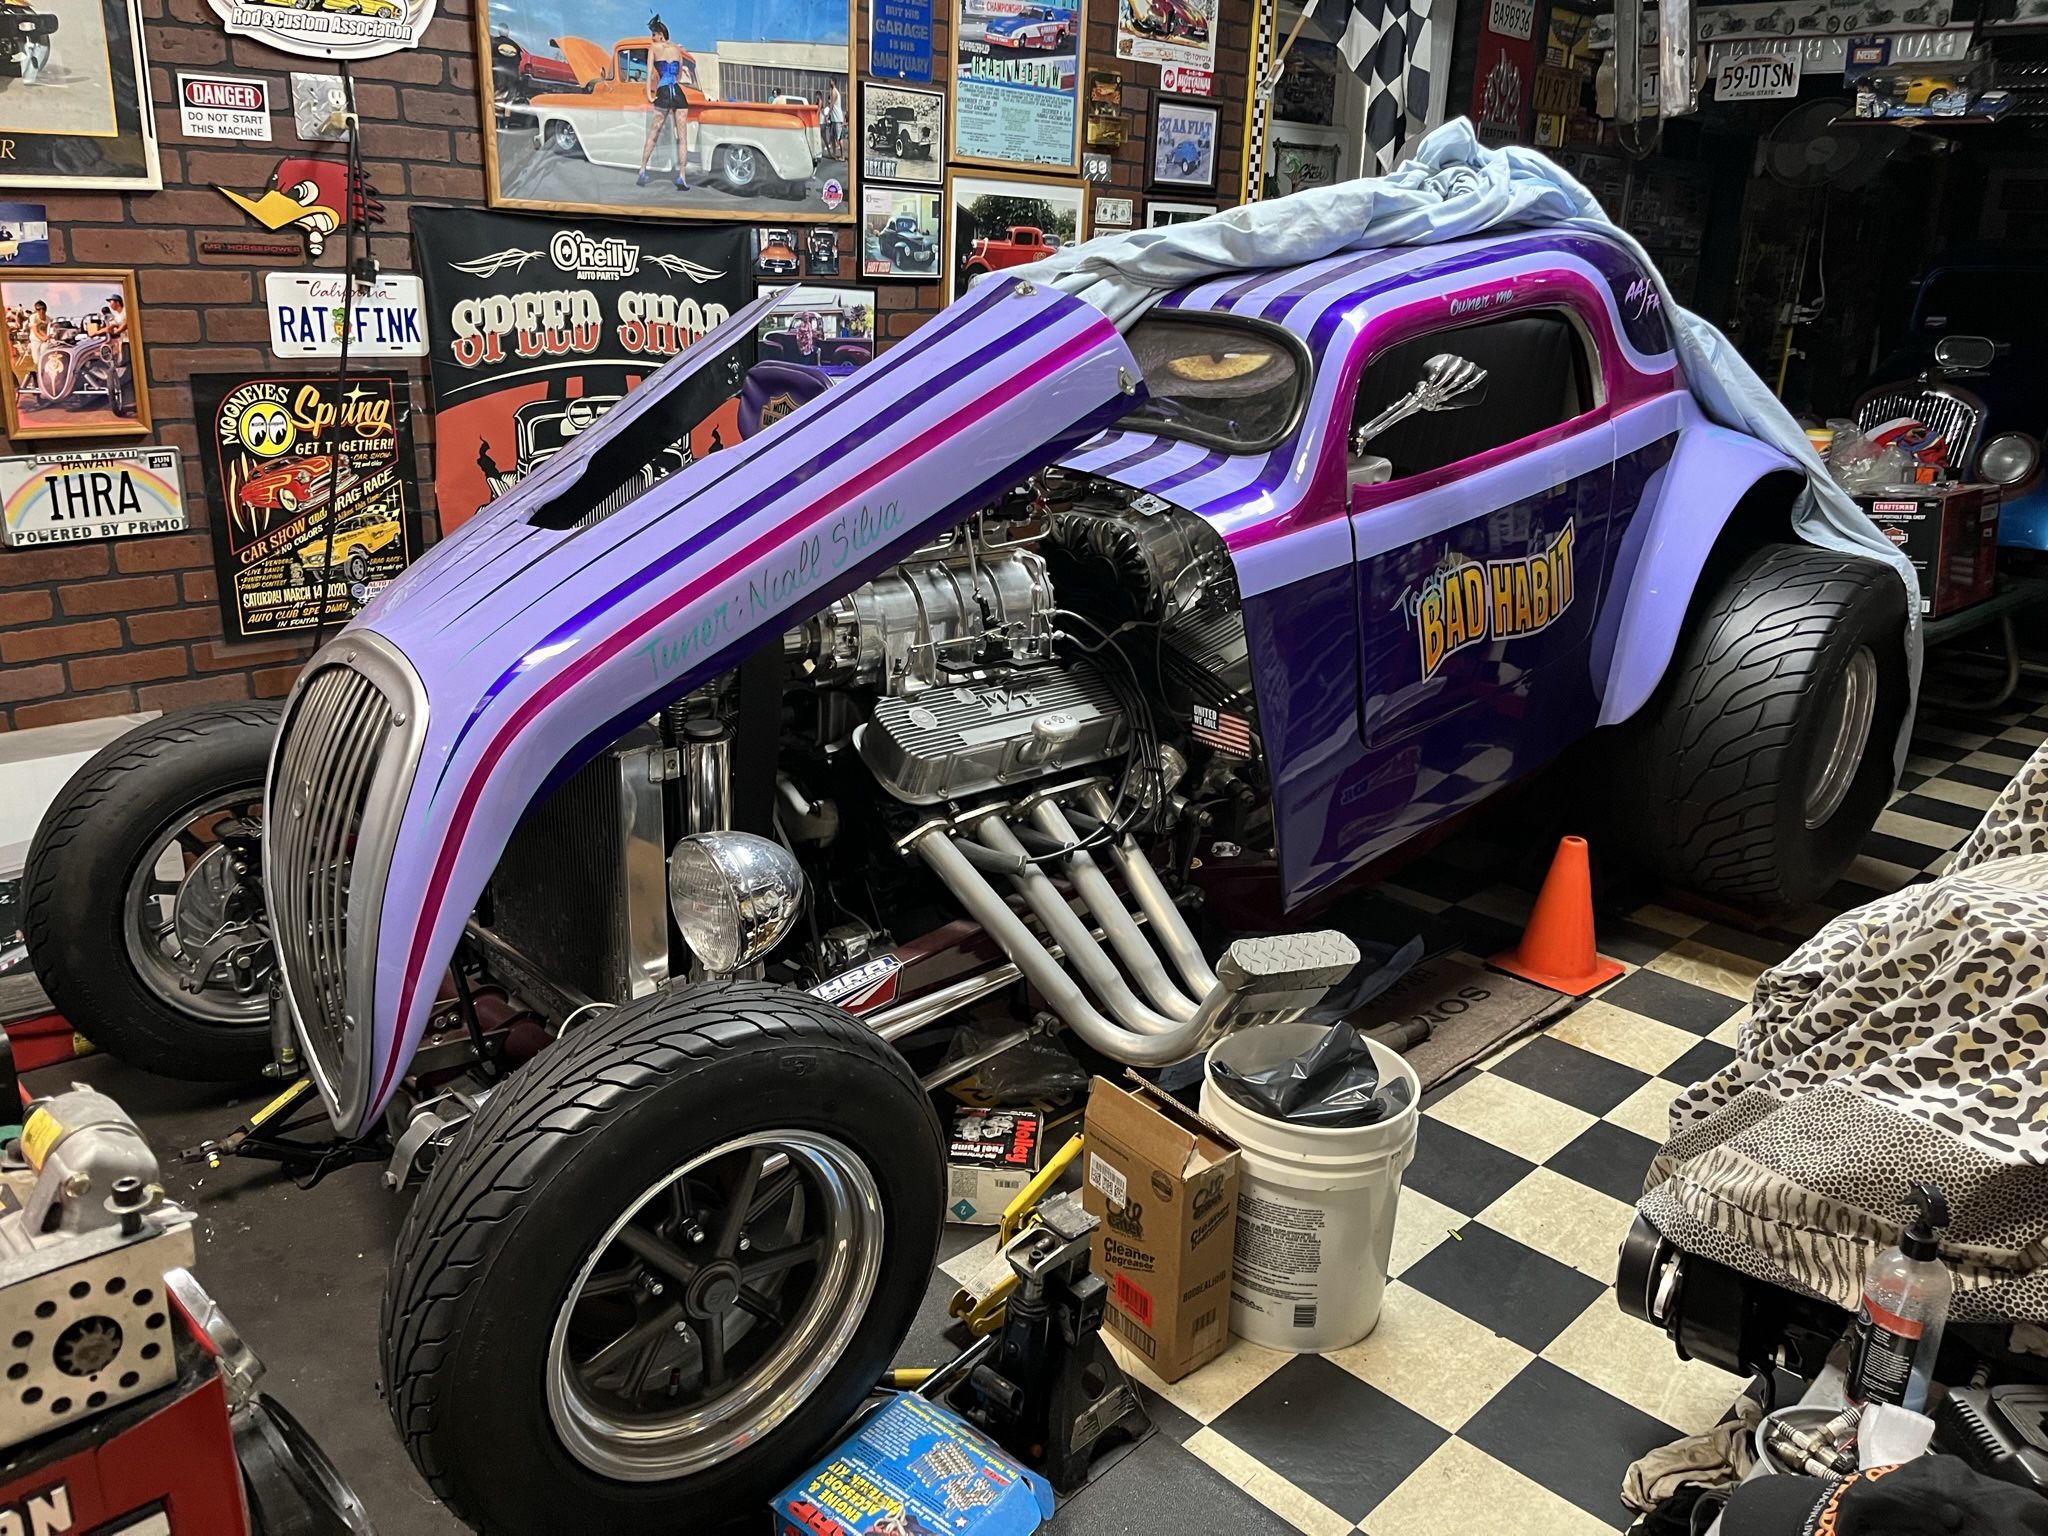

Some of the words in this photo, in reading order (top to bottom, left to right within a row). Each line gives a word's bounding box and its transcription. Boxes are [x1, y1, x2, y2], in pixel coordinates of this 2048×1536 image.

[331, 16, 412, 40] Association
[876, 18, 929, 40] GARAGE
[873, 51, 929, 74] SANCTUARY
[193, 81, 256, 108] DANGER
[188, 111, 203, 121] DO
[208, 113, 228, 122] NOT
[233, 114, 263, 125] START
[191, 125, 215, 134] THIS
[218, 126, 264, 137] MACHINE
[553, 232, 637, 273] O'Reilly
[577, 271, 596, 281] AUTO
[596, 271, 620, 281] PARTS
[1495, 289, 1514, 304] me
[278, 306, 328, 343] RAT
[355, 307, 421, 344] FINK
[451, 290, 602, 367] SPEED
[219, 383, 291, 446] MOONEYES
[39, 453, 82, 463] ALOHA
[91, 450, 136, 460] HAWAII
[295, 442, 320, 455] GET
[321, 437, 394, 454] TGETHER!!
[152, 456, 170, 464] JUN
[45, 470, 142, 521] IHRA
[241, 541, 269, 564] CAR
[269, 516, 306, 548] SHOW
[363, 466, 395, 496] RACE
[101, 524, 119, 536] BY
[281, 543, 293, 555] NO
[294, 524, 324, 547] COLORS
[243, 589, 282, 608] SATURDAY
[283, 586, 312, 602] MARCH
[326, 582, 348, 598] 2020
[1418, 562, 1487, 681] BAD
[1489, 520, 1573, 639] HABIT
[247, 611, 273, 624] AUTO
[276, 608, 299, 620] CLUB
[302, 602, 349, 618] SPEDWAY
[277, 619, 288, 628] IN
[1194, 704, 1217, 721] UNITED
[1194, 715, 1204, 727] WE
[1205, 717, 1218, 730] ROLL
[951, 1143, 980, 1154] Pump
[982, 1145, 1004, 1155] Fuel
[1005, 1120, 1037, 1164] Holley
[960, 1206, 966, 1215] 2
[1104, 1236, 1156, 1263] Cleaner
[1105, 1251, 1155, 1271] Degreaser
[827, 1460, 851, 1480] KIT
[985, 1452, 1006, 1472] World
[814, 1471, 880, 1516] ACCESSORY
[818, 1489, 862, 1524] ENGINE
